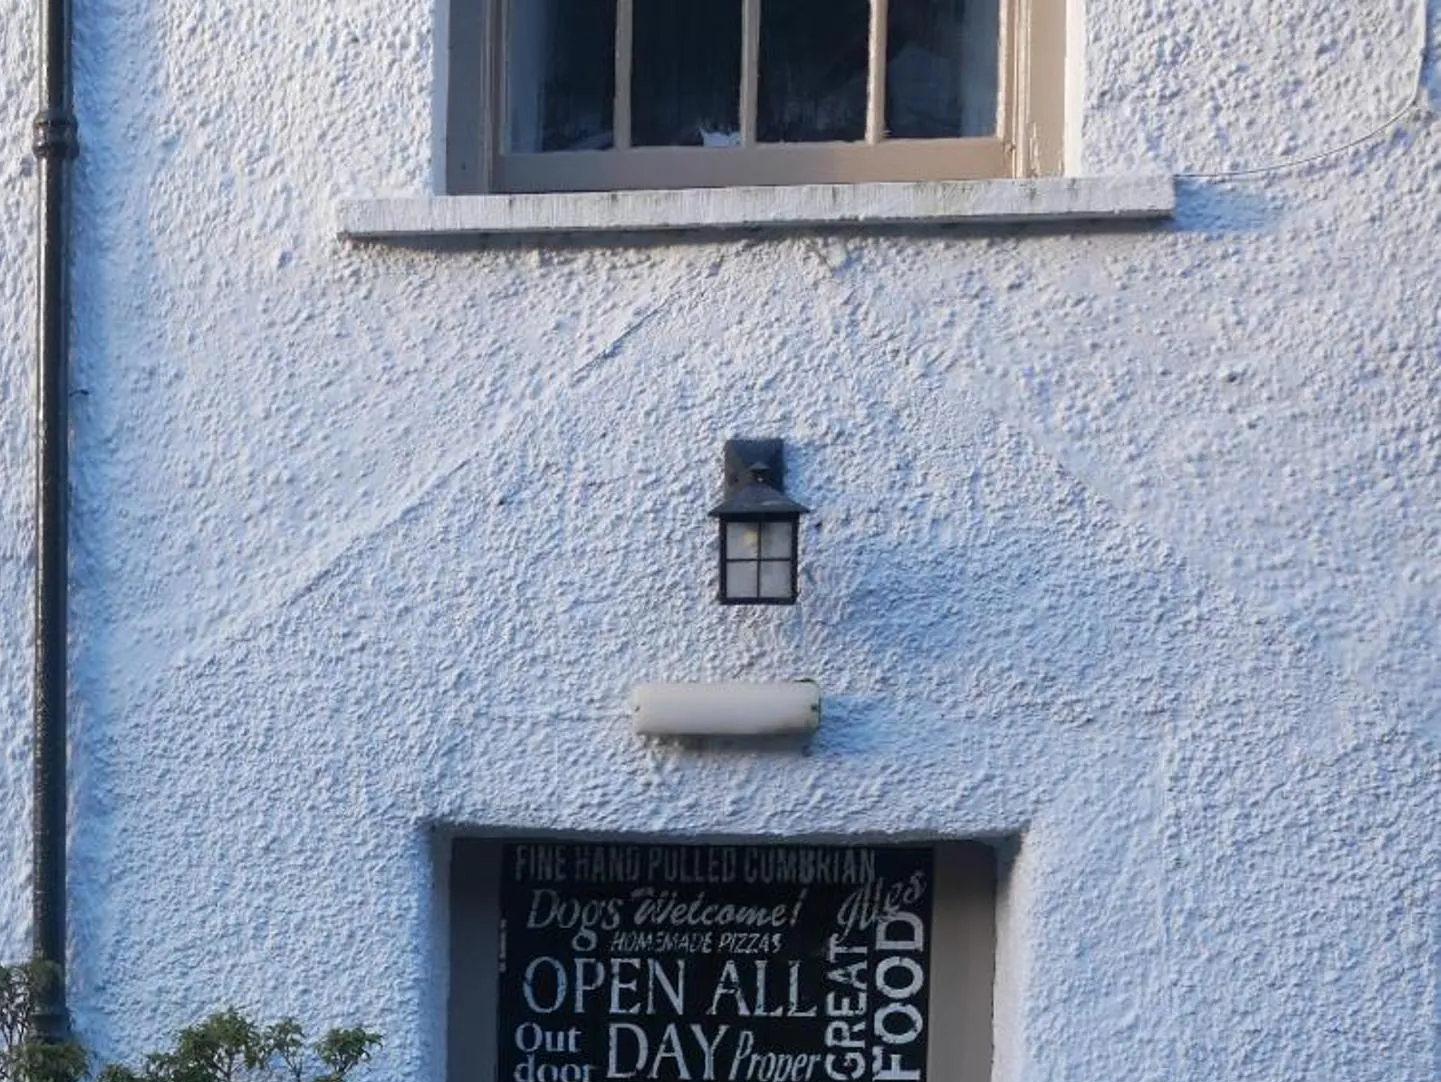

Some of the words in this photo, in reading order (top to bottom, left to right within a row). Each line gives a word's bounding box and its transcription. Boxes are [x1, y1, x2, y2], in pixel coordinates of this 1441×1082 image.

[515, 845, 567, 881] FINE
[574, 846, 641, 882] HAND
[648, 847, 737, 883] PULLED
[744, 847, 876, 884] CUMBRIAN
[527, 888, 625, 952] Dogs
[631, 886, 807, 927] Welcome!
[610, 931, 713, 953] HOMEMADE
[718, 932, 783, 954] PIZZAS
[523, 956, 685, 1015] OPEN
[706, 959, 817, 1018] ALL
[825, 934, 867, 1082] GREAT
[872, 910, 925, 1082] FOOD
[514, 1022, 582, 1053] Out
[606, 1023, 729, 1081] DAY
